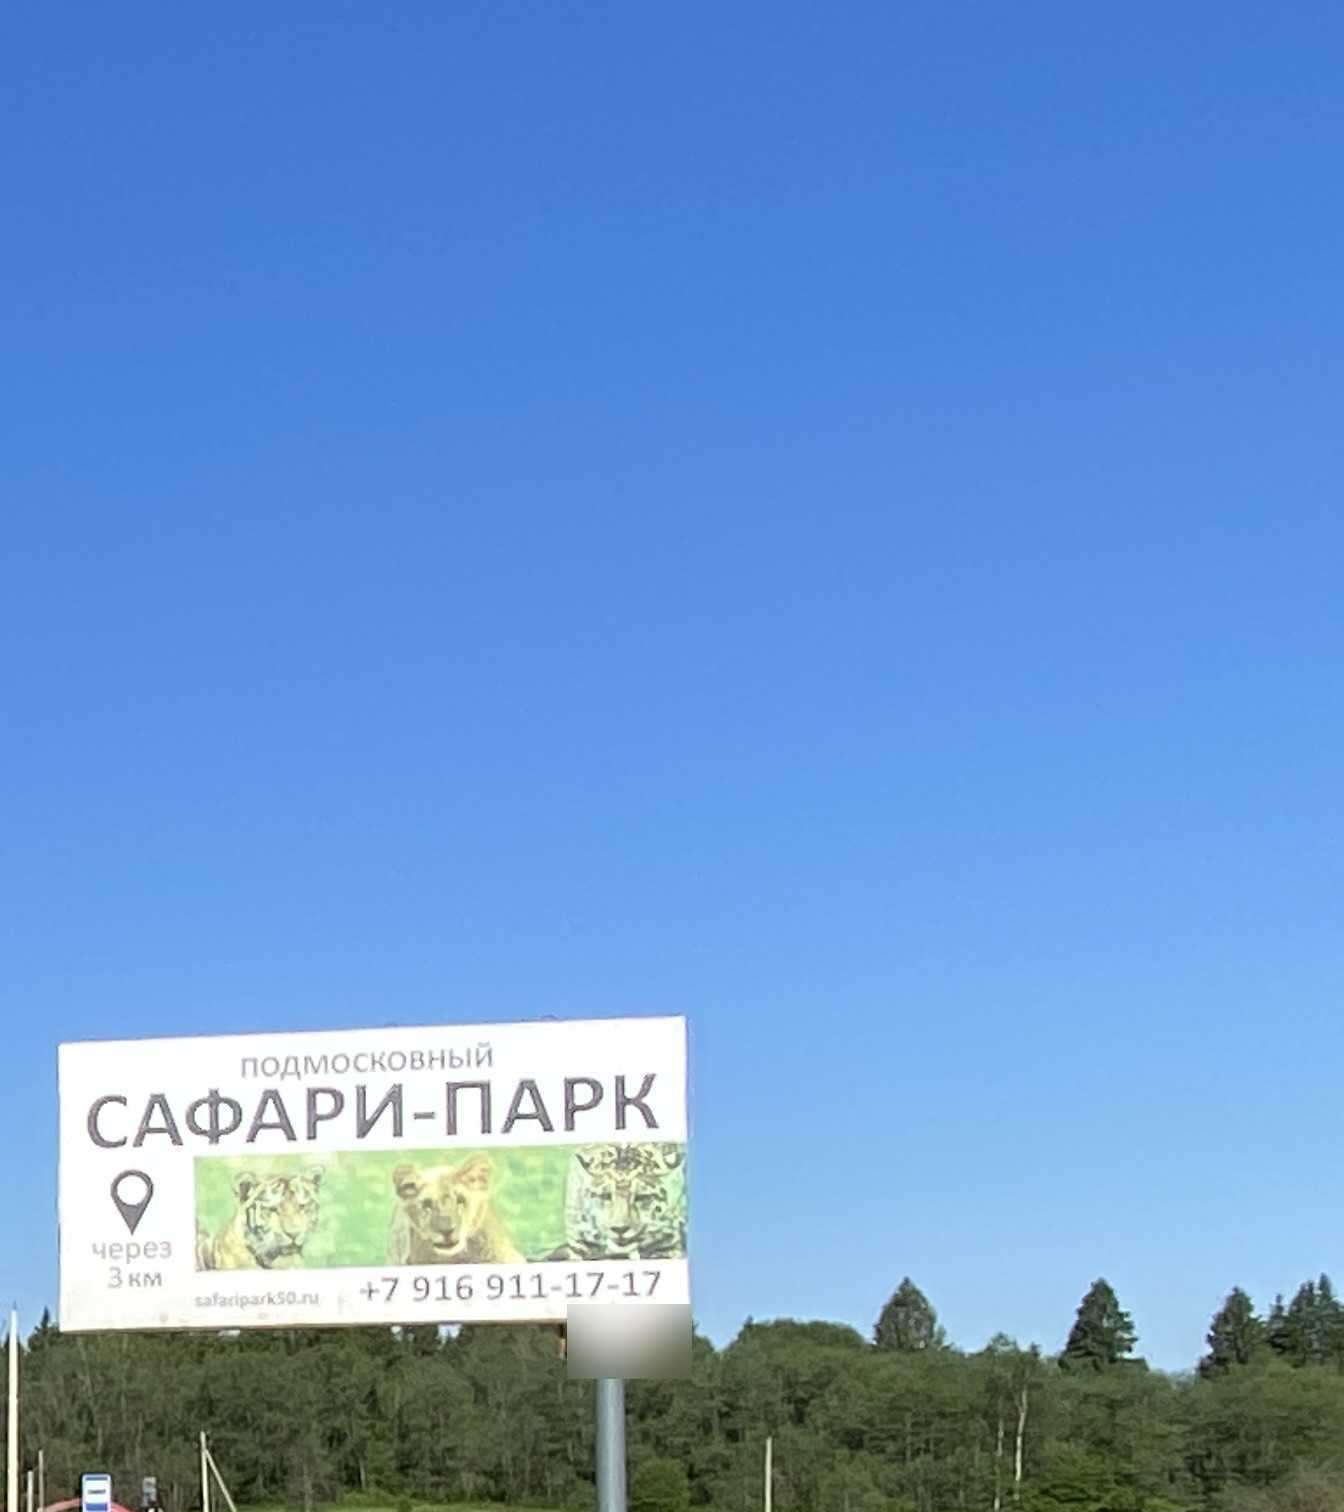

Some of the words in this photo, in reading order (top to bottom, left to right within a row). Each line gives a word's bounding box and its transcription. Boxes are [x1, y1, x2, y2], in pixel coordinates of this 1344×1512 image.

[85, 1073, 661, 1149] САФАРИ-ПАРК
[91, 1240, 173, 1265] через
[107, 1265, 123, 1289] 3
[128, 1271, 163, 1288] км
[359, 1276, 400, 1302] +7
[412, 1274, 474, 1302] 916
[486, 1270, 662, 1300] 911-17-17
[194, 1290, 320, 1311] safaripark50.ru
